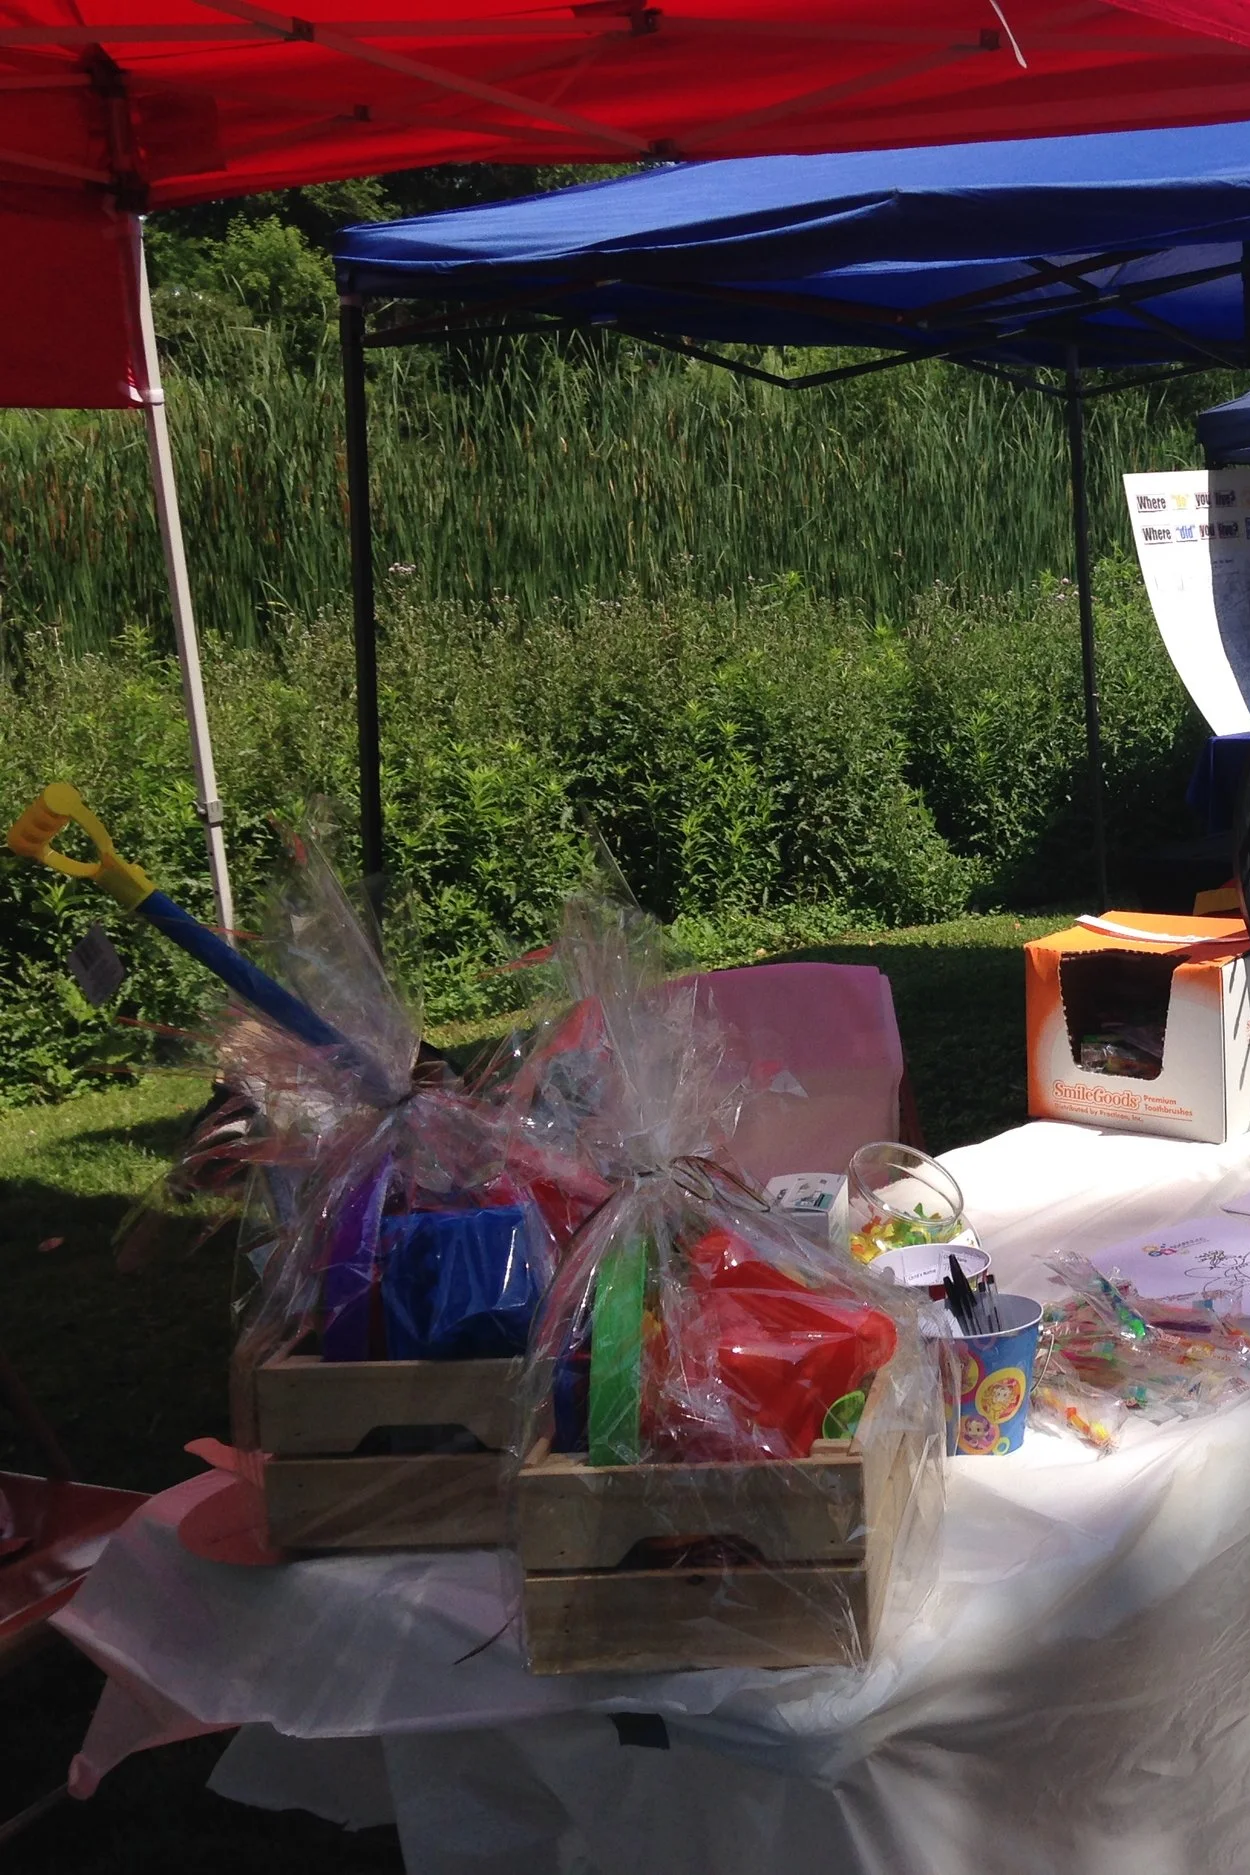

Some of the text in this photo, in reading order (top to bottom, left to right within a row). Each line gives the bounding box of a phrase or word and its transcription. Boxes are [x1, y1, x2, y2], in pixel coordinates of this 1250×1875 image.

[1137, 495, 1166, 509] Where
[1195, 492, 1212, 507] you
[1142, 527, 1171, 541] Where
[1054, 1081, 1177, 1109] SmileGoods Premium
[1054, 1103, 1088, 1114] Distributed
[1090, 1107, 1098, 1116] by
[1144, 1104, 1193, 1116] Toothbrushes
